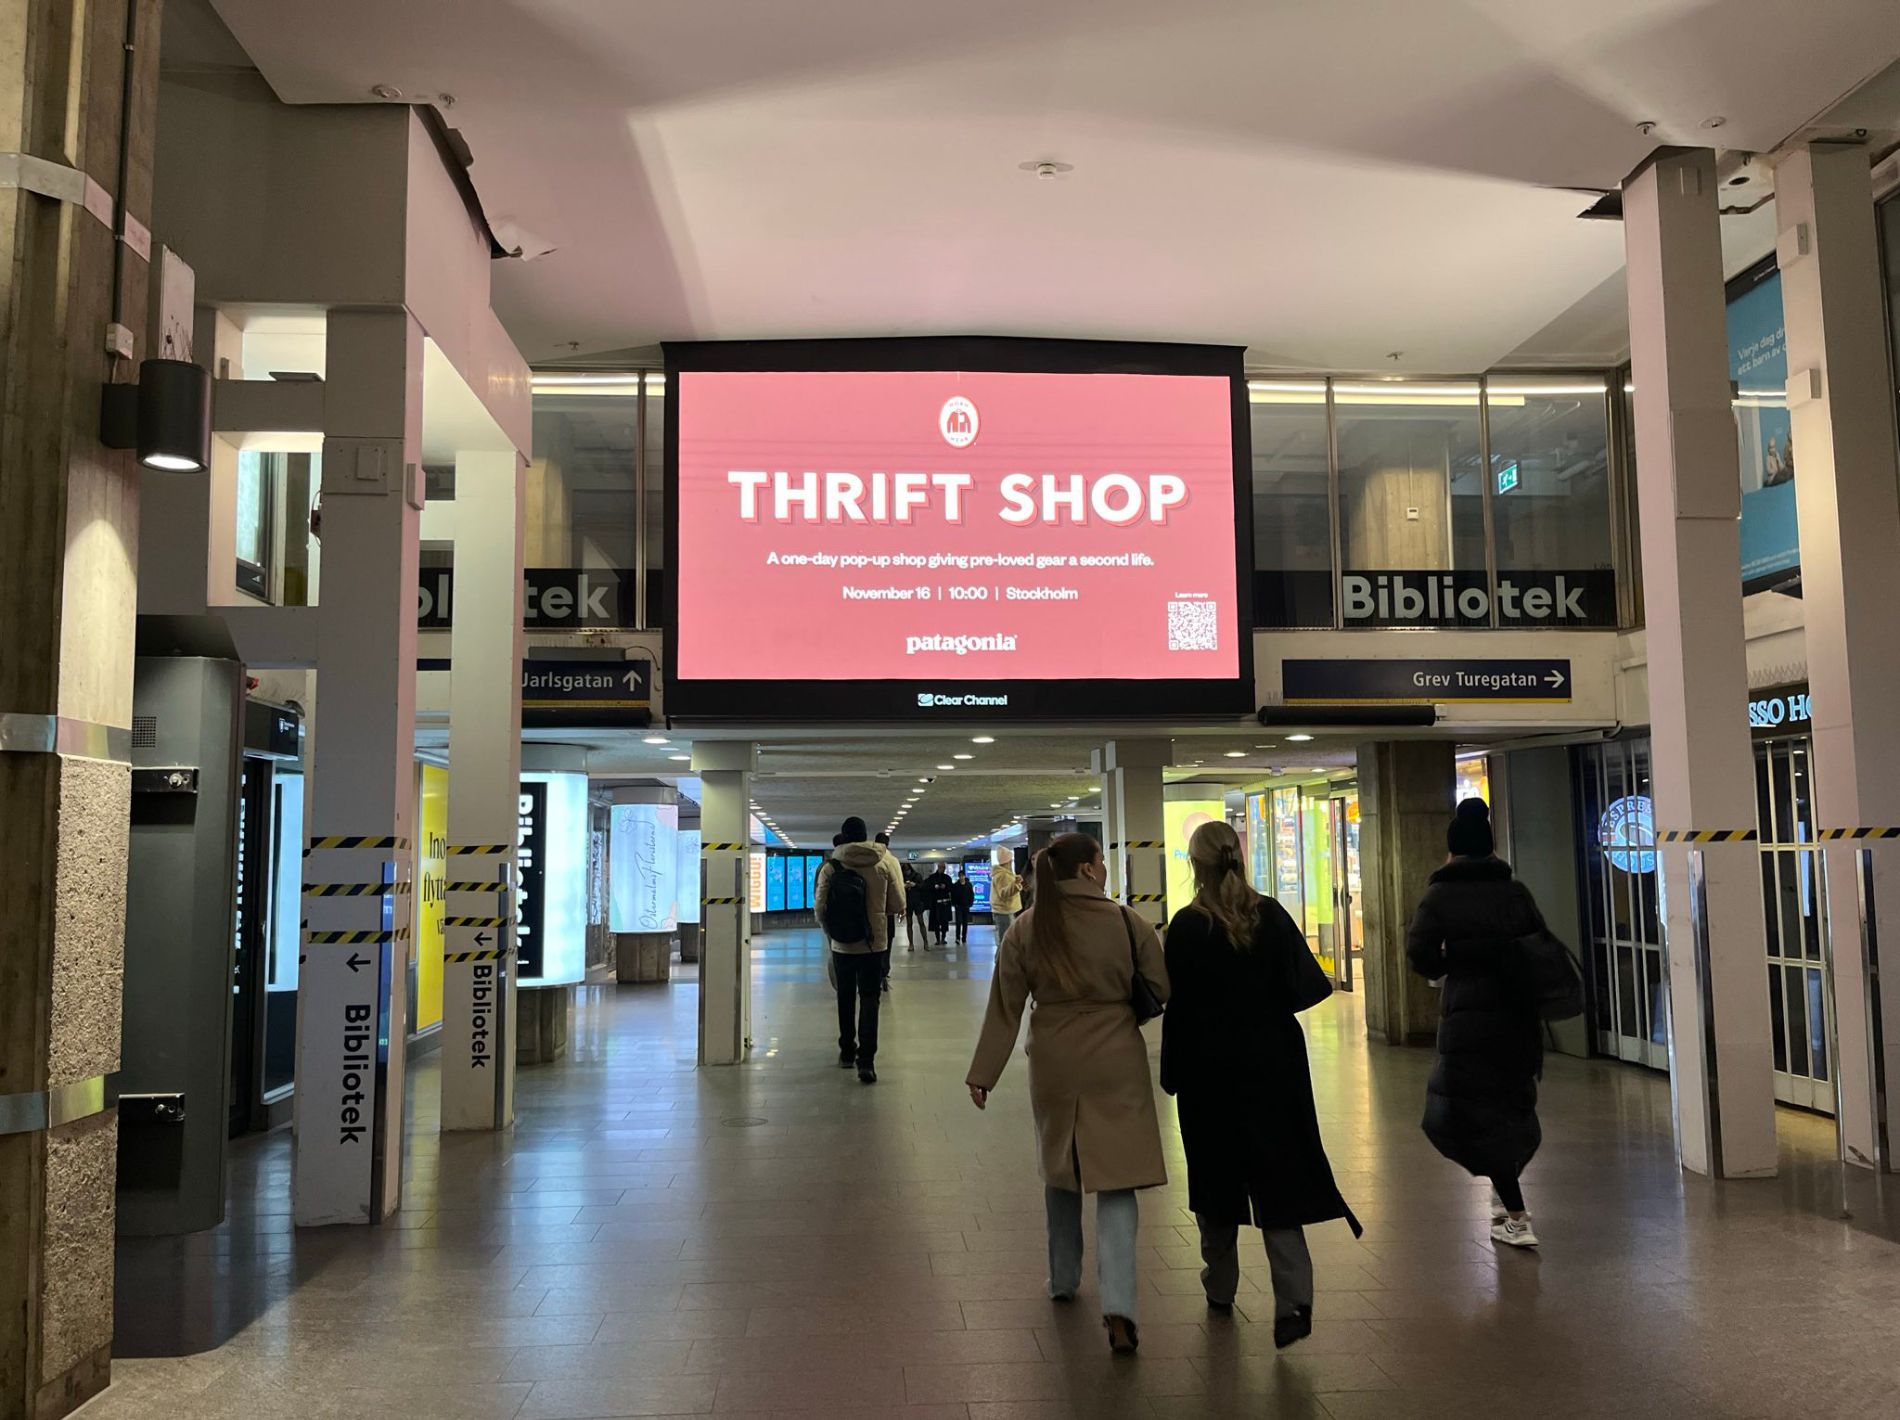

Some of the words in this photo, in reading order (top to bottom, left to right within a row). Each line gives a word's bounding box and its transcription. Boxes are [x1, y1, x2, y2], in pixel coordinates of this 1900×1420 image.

[728, 471, 972, 523] THRIFT
[999, 473, 1189, 525] SHOP
[767, 552, 779, 565] A
[781, 552, 838, 568] one-day
[840, 554, 891, 568] pop-up
[892, 553, 927, 568] shop
[928, 553, 968, 568] giving
[970, 553, 1034, 569] pre-loved
[1036, 555, 1067, 569] gear
[1068, 556, 1078, 566] a
[1080, 553, 1129, 566] second
[1131, 553, 1155, 566] life.
[843, 586, 914, 600] November
[915, 587, 931, 600] 16
[949, 587, 988, 600] 10:00
[1006, 586, 1078, 600] Stockholm
[1343, 575, 1587, 619] Bibliotek
[906, 632, 1017, 655] patagonia
[522, 671, 613, 691] Jarlsgatan
[1413, 672, 1450, 687] Grev
[1456, 671, 1537, 690] Turegatan
[934, 695, 963, 705] Clear
[963, 694, 1007, 705] Channel
[472, 965, 492, 1069] Bibliotek
[340, 1005, 370, 1145] Bibliotek
